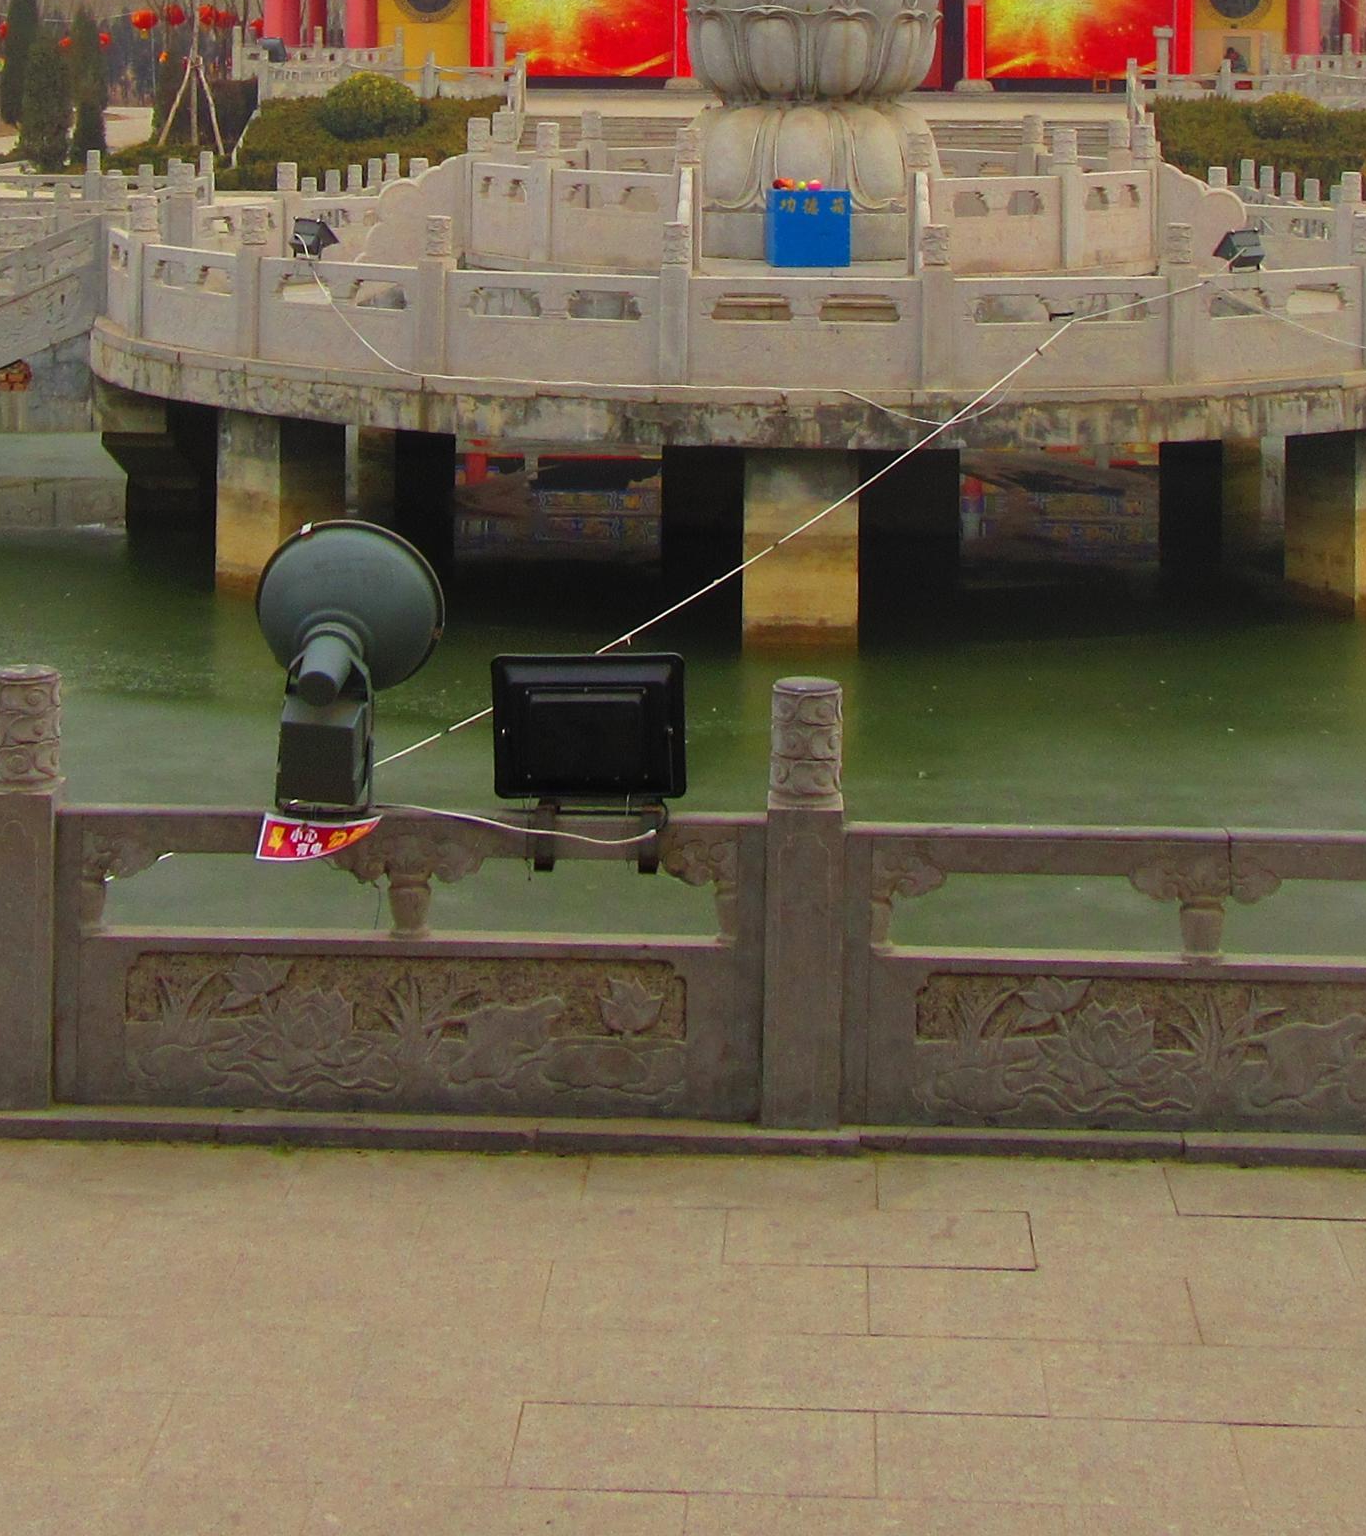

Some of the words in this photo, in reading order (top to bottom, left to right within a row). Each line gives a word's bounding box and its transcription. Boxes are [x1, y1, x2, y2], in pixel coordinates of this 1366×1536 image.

[779, 197, 845, 216] 功德箱
[290, 826, 318, 844] 小心
[296, 842, 324, 857] 有电
